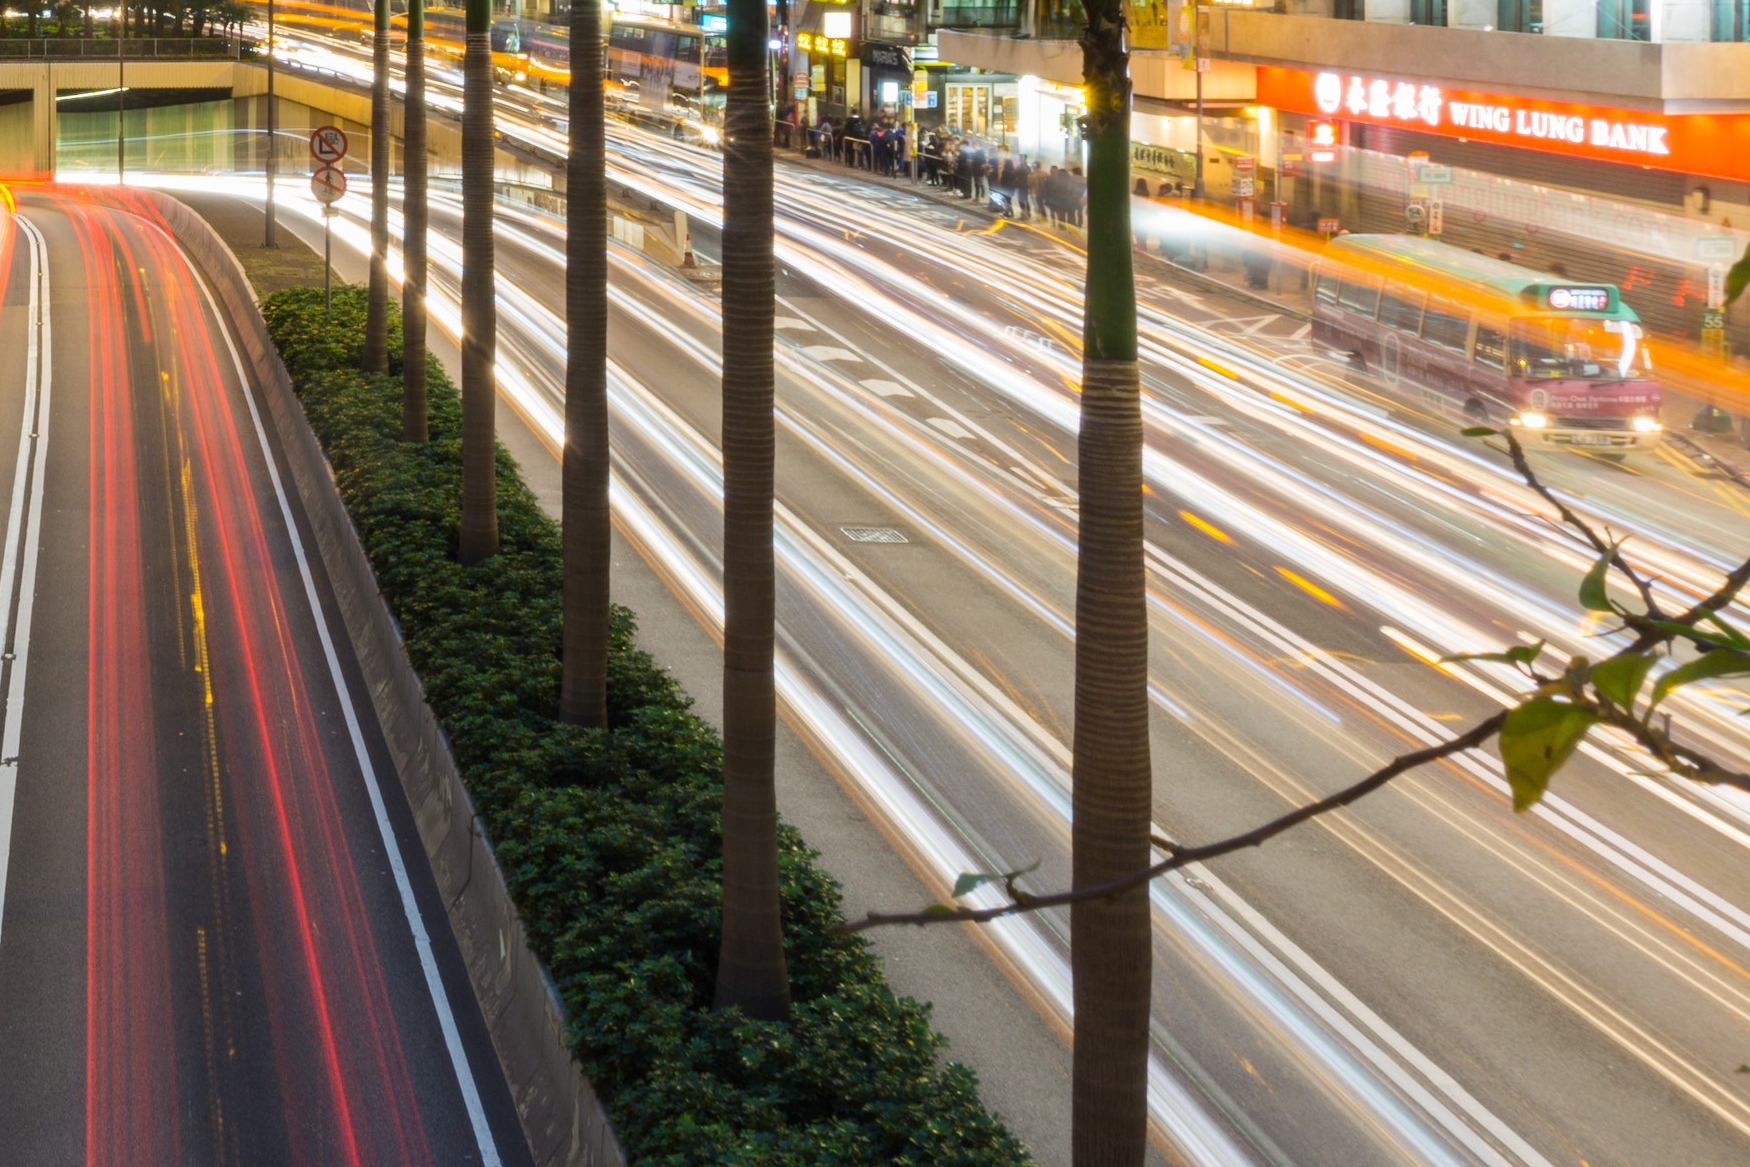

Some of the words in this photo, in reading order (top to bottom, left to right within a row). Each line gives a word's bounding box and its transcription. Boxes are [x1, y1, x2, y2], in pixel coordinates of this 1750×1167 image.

[1449, 101, 1511, 132] WING
[1515, 109, 1585, 144] LUNG
[1591, 119, 1670, 155] BANK
